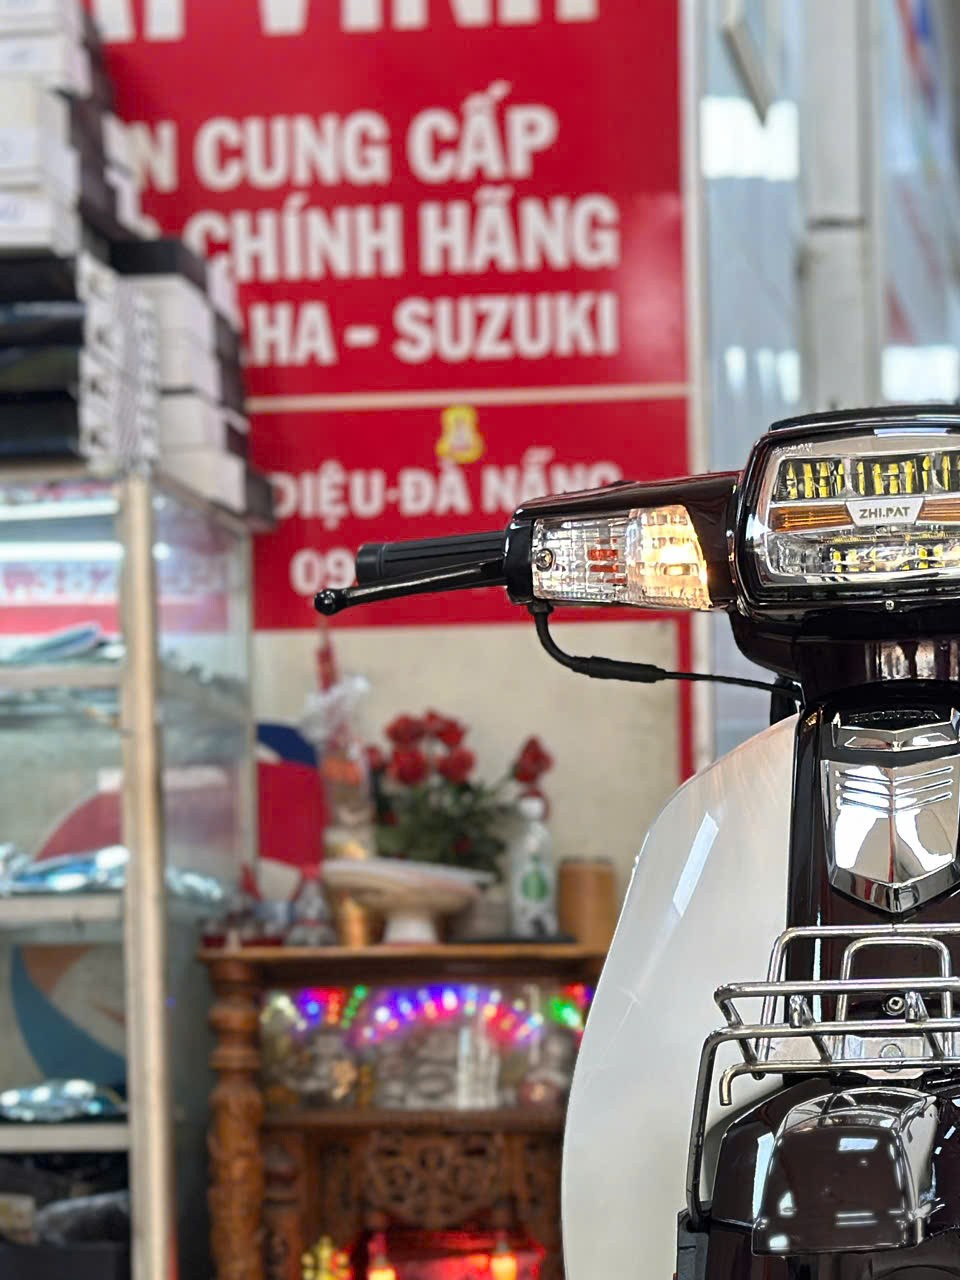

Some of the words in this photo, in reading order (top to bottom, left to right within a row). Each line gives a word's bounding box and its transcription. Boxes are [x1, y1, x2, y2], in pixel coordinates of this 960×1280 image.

[132, 119, 178, 192] N
[193, 110, 392, 191] CUNG
[406, 82, 560, 184] CẤP
[184, 191, 403, 284] CHÍNH
[418, 185, 621, 275] HÃNG
[245, 301, 337, 368] HA
[392, 291, 621, 364] SUZUKI
[858, 505, 911, 520] ZHI.PAT
